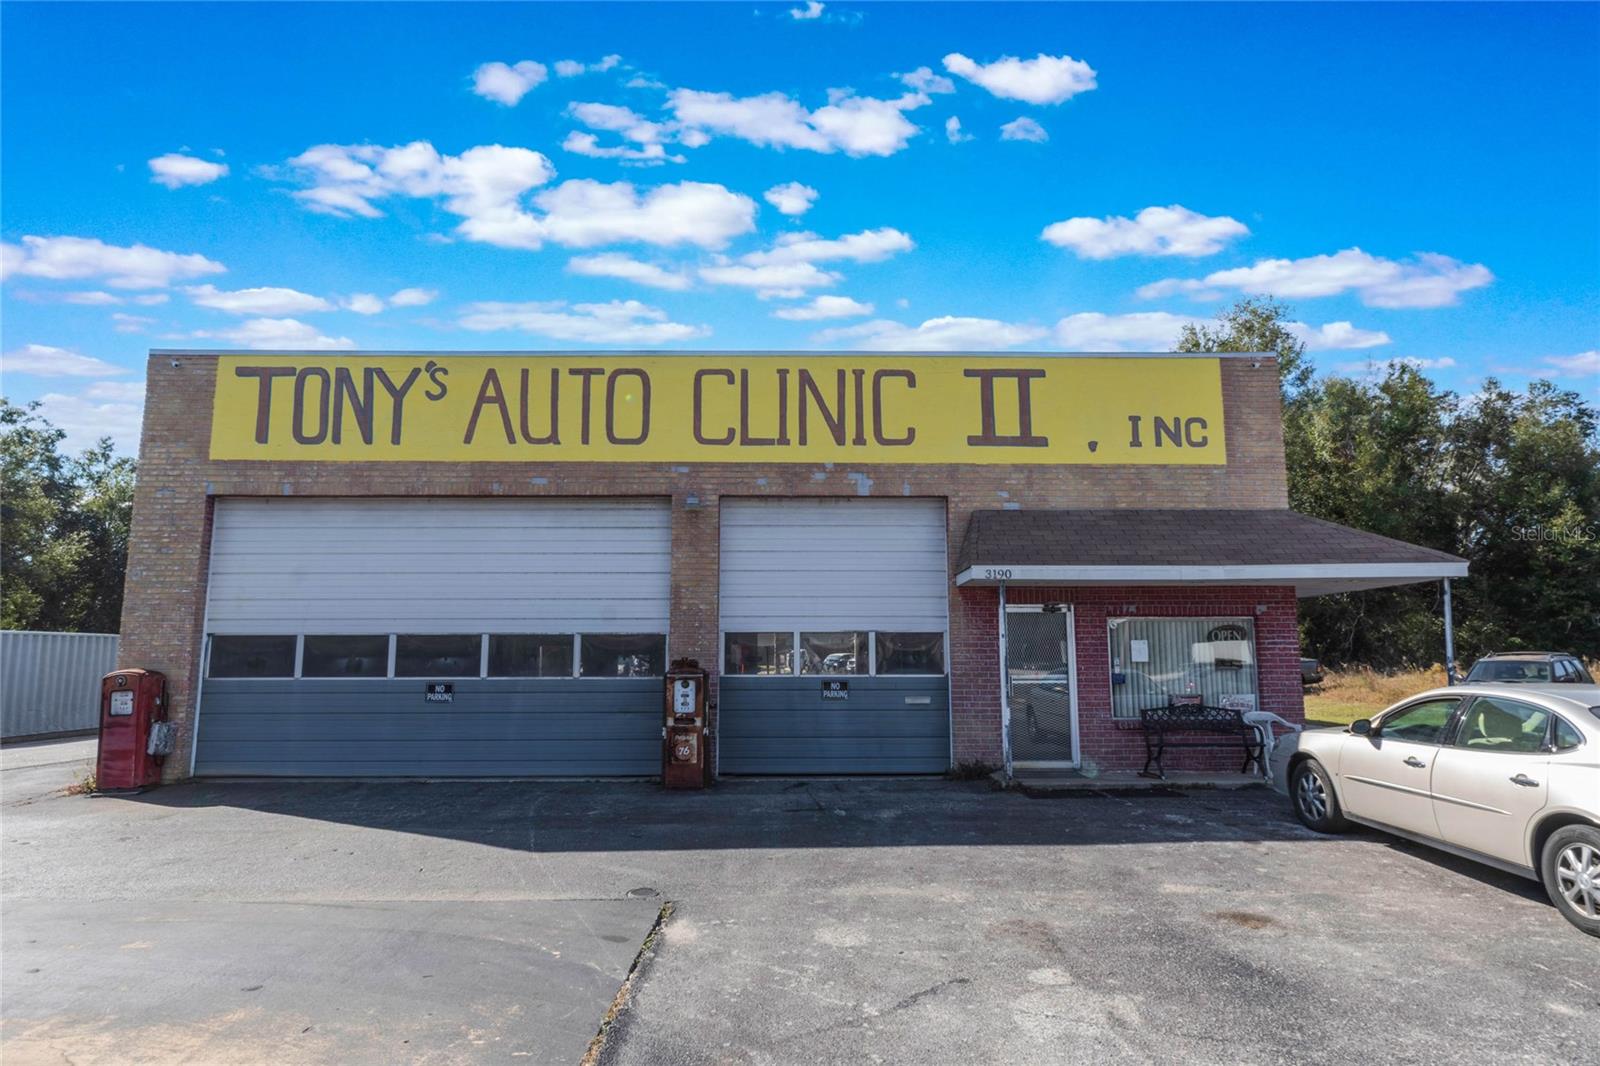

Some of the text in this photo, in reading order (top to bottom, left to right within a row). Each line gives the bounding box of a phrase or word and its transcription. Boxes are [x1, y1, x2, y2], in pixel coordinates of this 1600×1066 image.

[463, 368, 651, 446] AUTO
[693, 368, 917, 447] CLINIC
[963, 368, 1049, 447] II
[985, 569, 1012, 579] 3190
[1211, 630, 1242, 641] OPEN
[427, 693, 452, 701] PARKING
[823, 691, 848, 699] PARKING
[678, 746, 690, 755] 76
